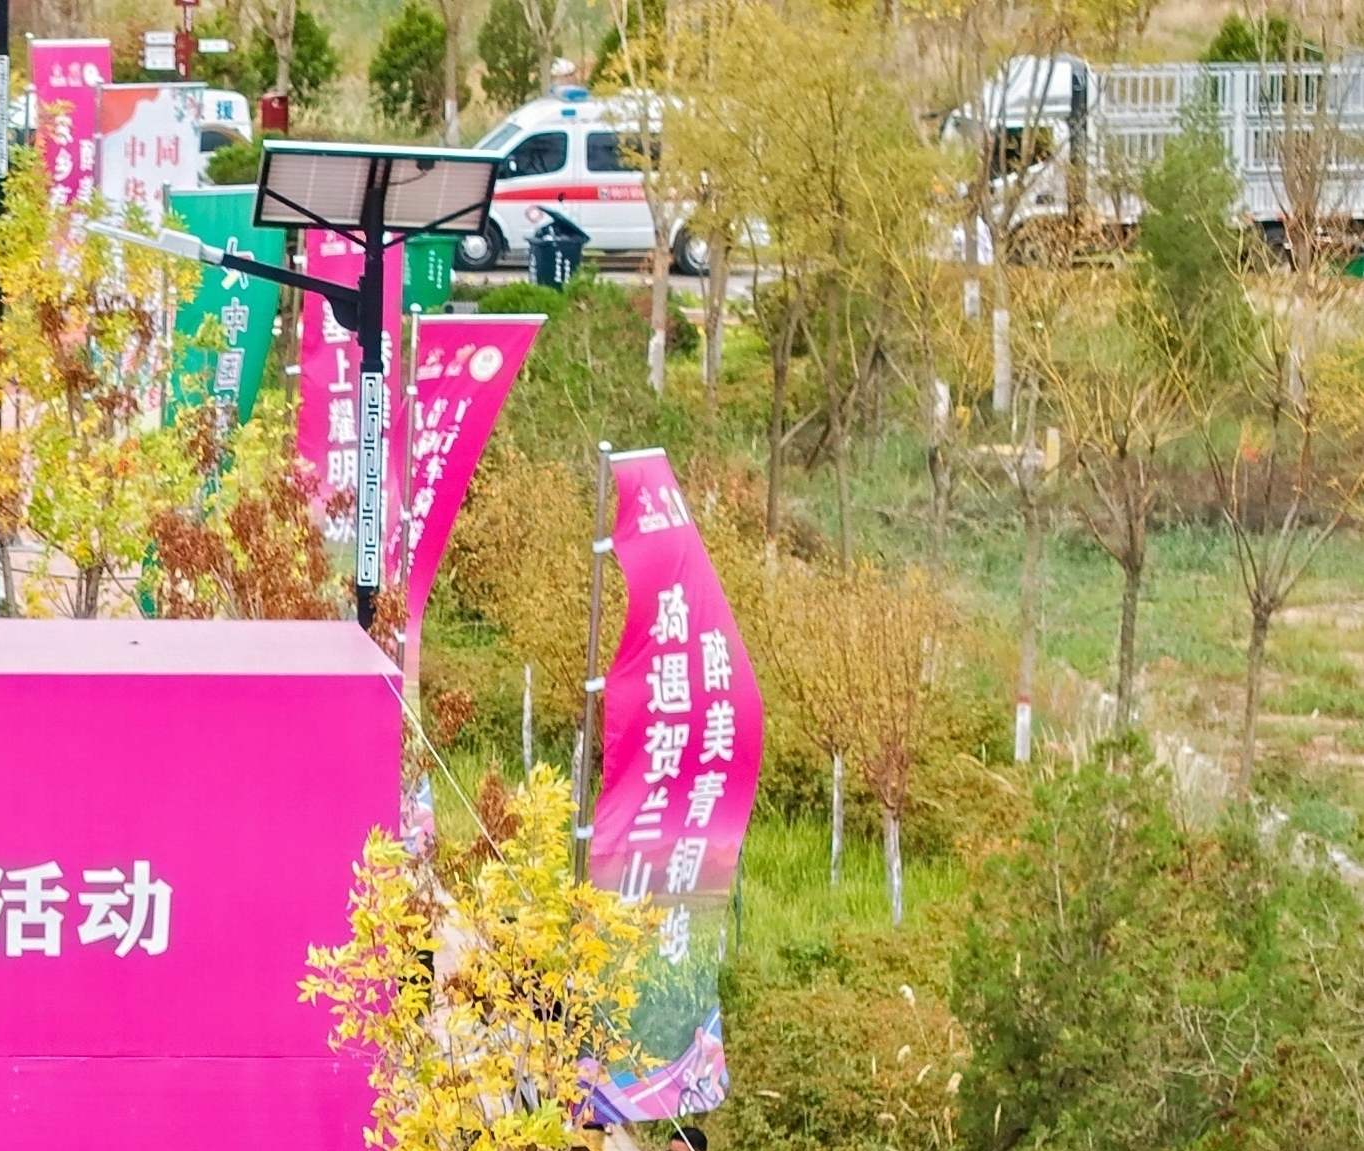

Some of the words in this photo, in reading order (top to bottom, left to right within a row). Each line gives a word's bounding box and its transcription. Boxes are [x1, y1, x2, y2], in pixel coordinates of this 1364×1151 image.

[617, 582, 692, 905] 骑遇贺兰山
[657, 629, 736, 964] 醉美青铜峡
